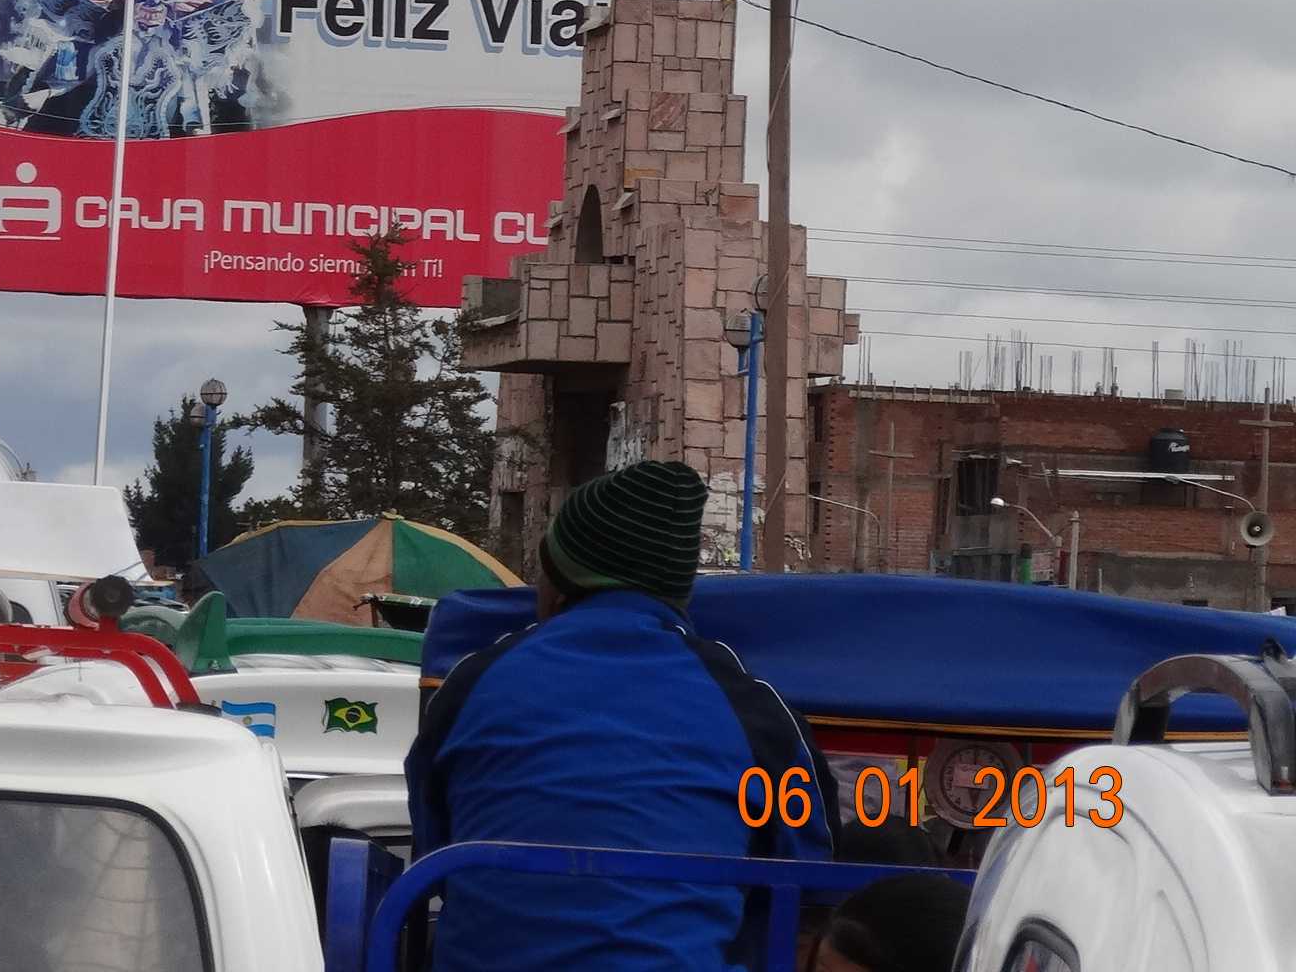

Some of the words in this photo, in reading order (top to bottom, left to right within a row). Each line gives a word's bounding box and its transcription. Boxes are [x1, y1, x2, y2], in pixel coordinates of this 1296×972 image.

[75, 195, 204, 230] CAJA
[222, 199, 481, 242] MUNICIPAL
[204, 251, 305, 274] ¡Pensando
